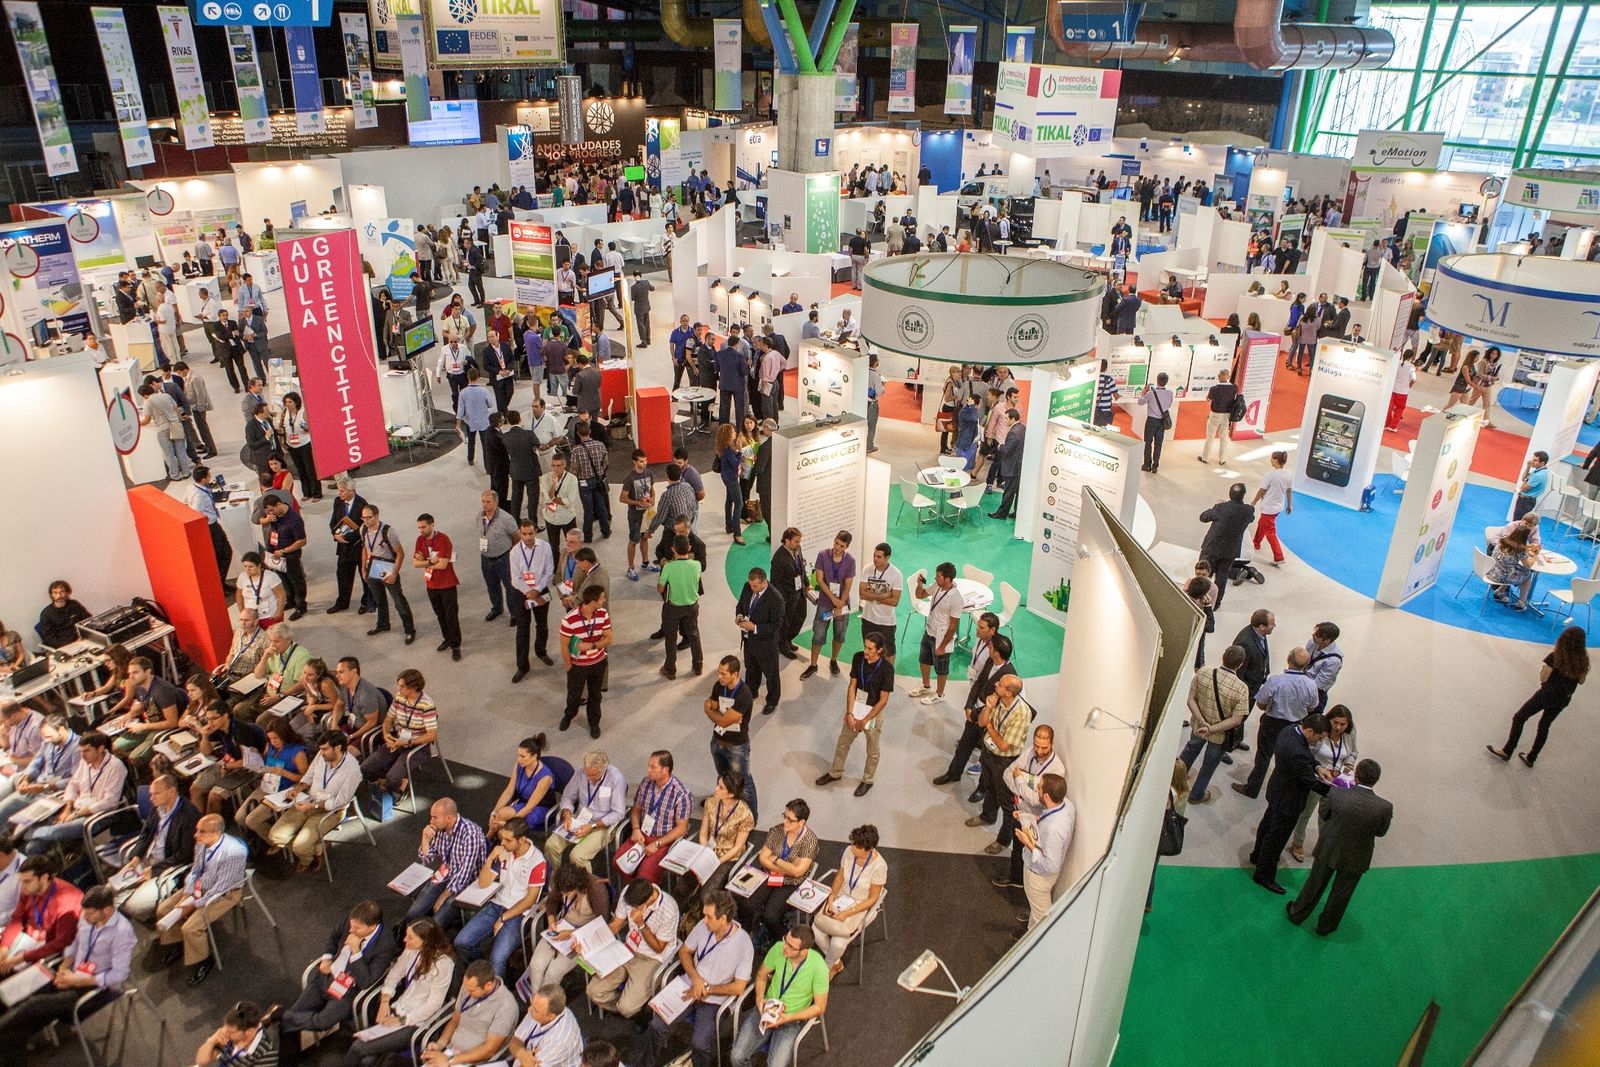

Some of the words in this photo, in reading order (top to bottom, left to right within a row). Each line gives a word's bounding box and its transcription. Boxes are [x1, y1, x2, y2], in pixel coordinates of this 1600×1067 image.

[480, 0, 541, 15] TIKAL
[470, 32, 497, 40] FEDER
[1112, 20, 1121, 40] 1
[171, 46, 193, 56] RIVAS
[1059, 75, 1091, 83] greencities
[1058, 83, 1098, 92] sostenibilidad
[995, 114, 1011, 134] TIKAL
[1036, 125, 1072, 141] TIKAL
[536, 143, 567, 154] AMOS
[569, 139, 621, 151] CIUDADES
[1381, 147, 1427, 158] eMotion
[569, 148, 622, 159] PROGRESO
[290, 240, 318, 329] AULA
[1472, 293, 1514, 329] M
[905, 325, 924, 333] CIES
[312, 236, 363, 464] GREENCITIES
[1317, 365, 1342, 377] Málaga
